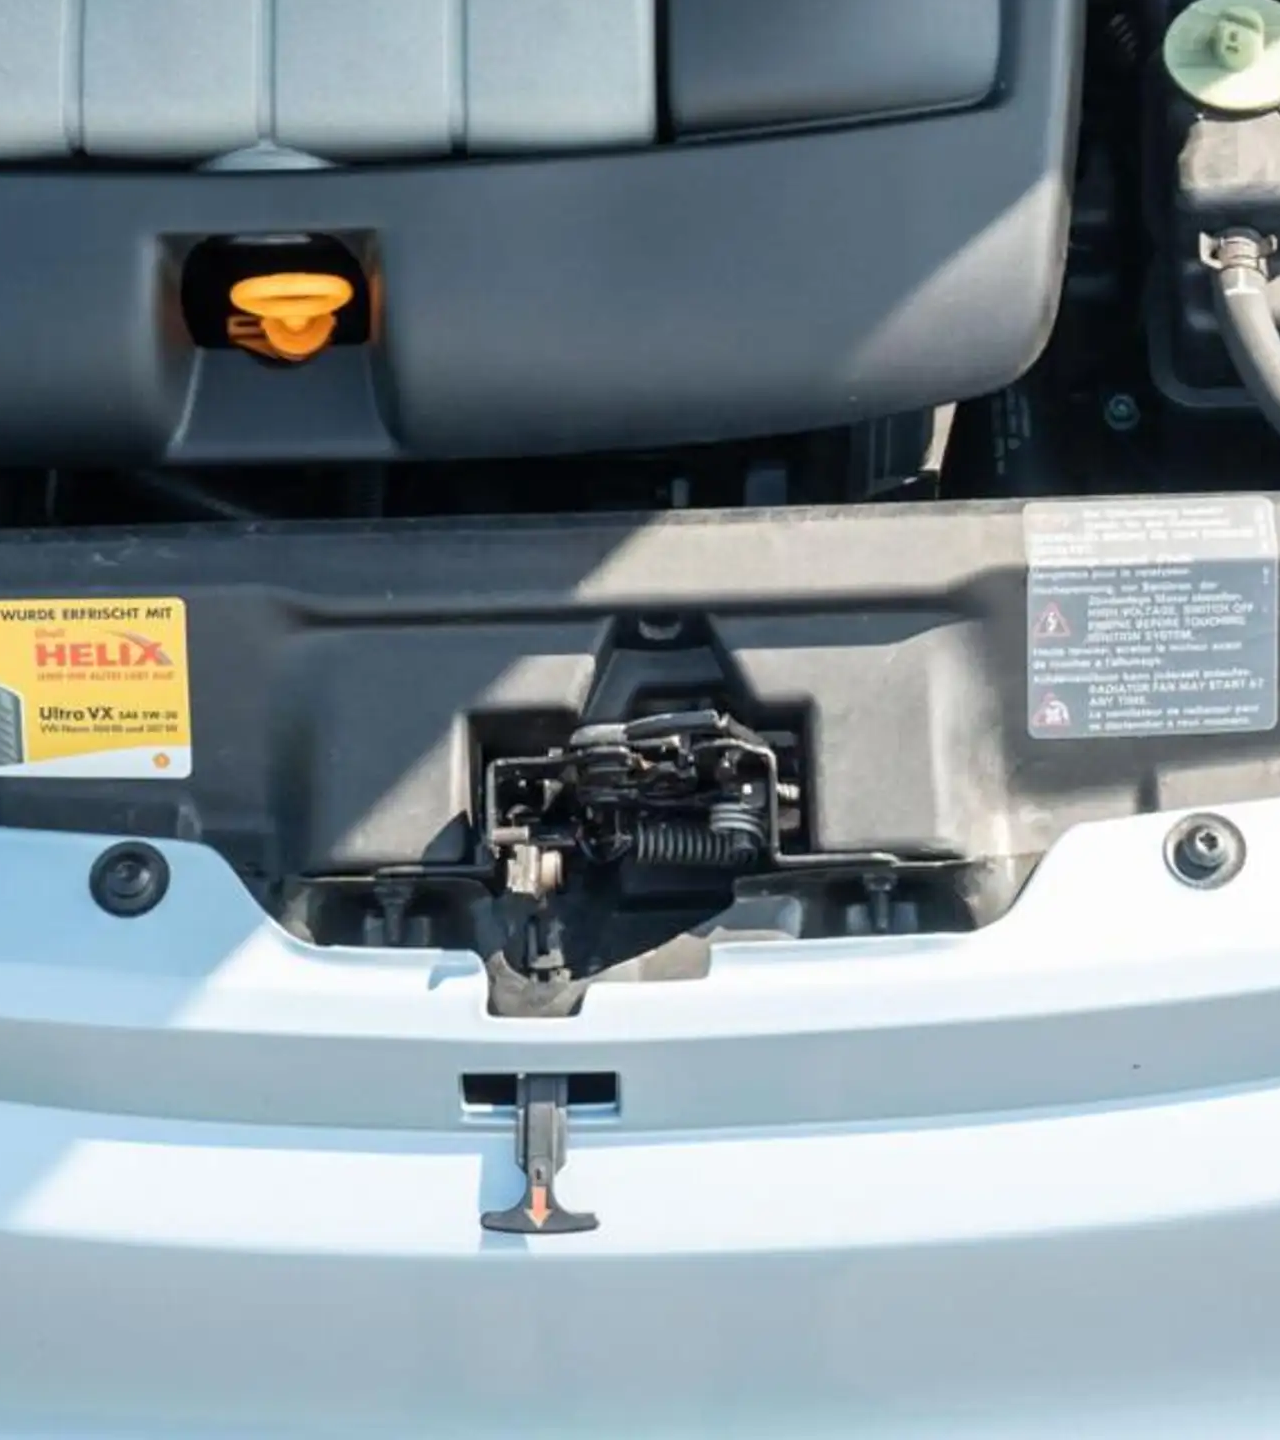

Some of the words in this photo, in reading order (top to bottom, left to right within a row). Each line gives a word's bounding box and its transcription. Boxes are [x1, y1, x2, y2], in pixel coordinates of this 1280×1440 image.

[0, 608, 56, 621] WURDE
[62, 607, 139, 620] ERFRISCHT
[145, 606, 173, 620] MIT
[35, 642, 164, 667] HELIX
[39, 706, 85, 721] Ultra
[88, 706, 114, 721] VX
